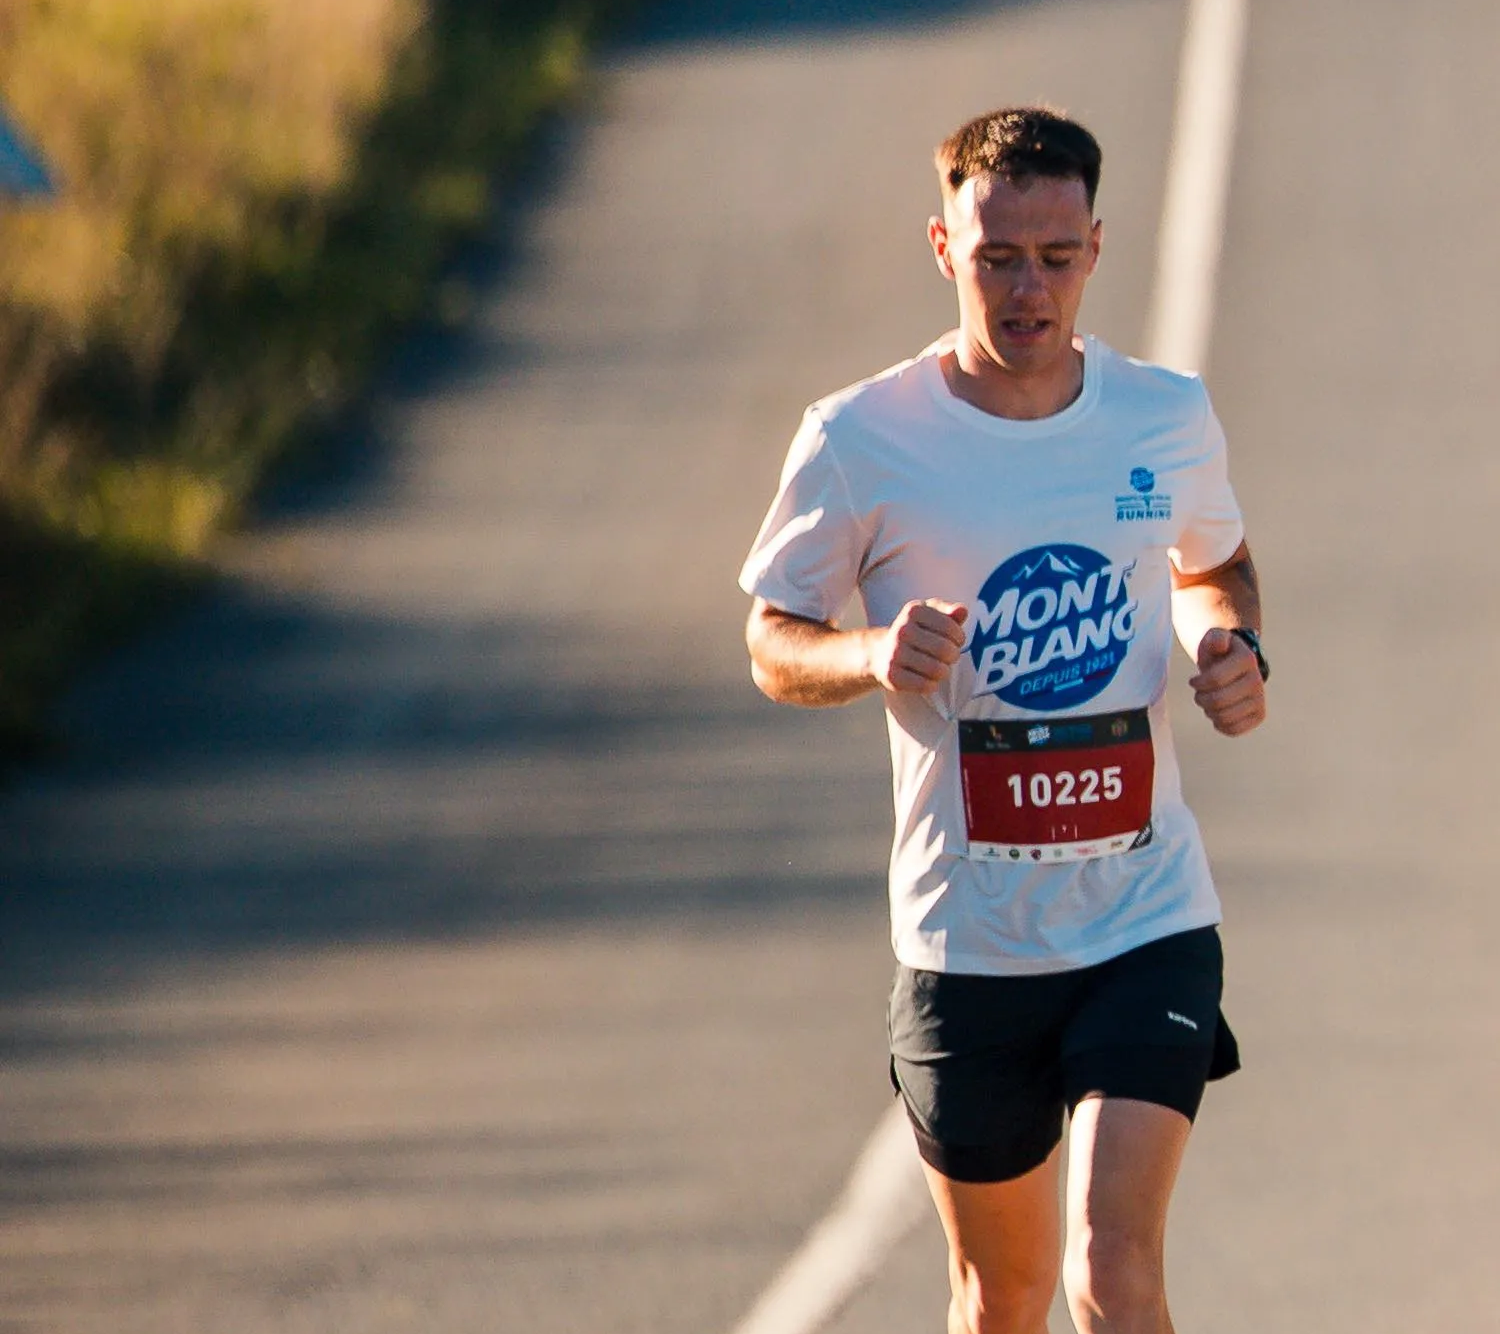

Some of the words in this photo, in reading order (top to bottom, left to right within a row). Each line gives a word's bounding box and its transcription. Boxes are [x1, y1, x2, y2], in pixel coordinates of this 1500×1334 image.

[968, 561, 1137, 641] MONT
[974, 601, 1138, 695] BLANC
[1007, 766, 1122, 808] 10225
